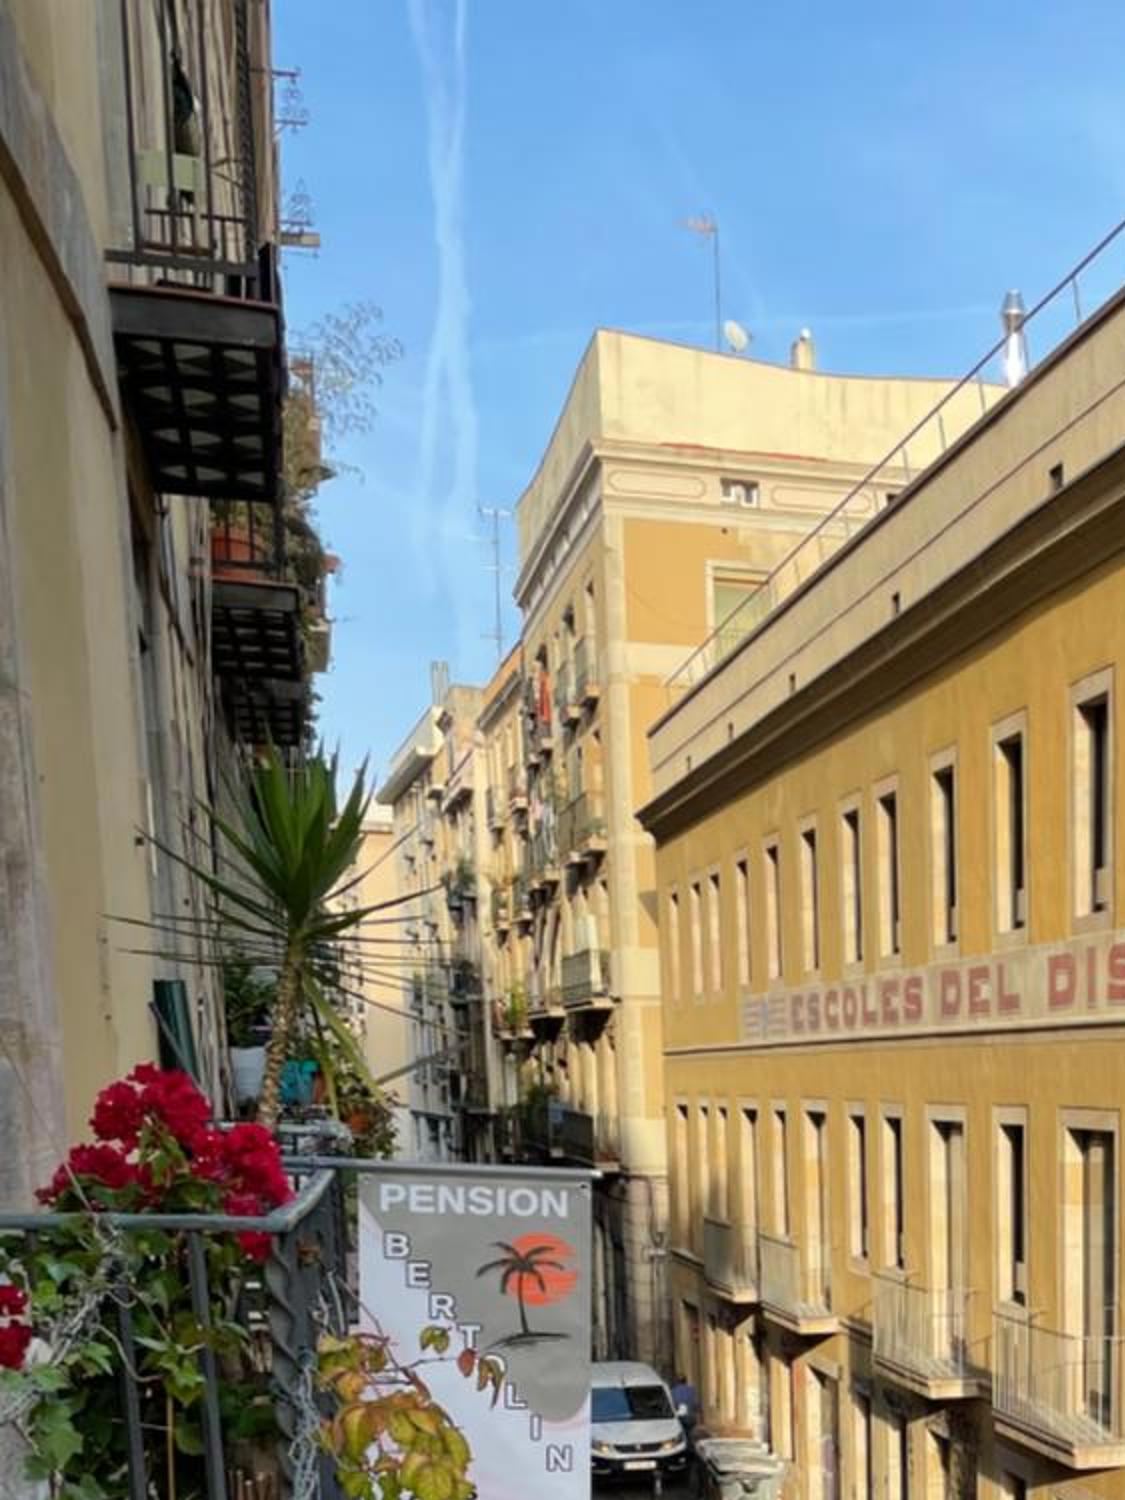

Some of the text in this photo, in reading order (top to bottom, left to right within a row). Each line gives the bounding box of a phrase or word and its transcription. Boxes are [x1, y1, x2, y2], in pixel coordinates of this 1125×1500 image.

[790, 975, 923, 1033] ESCOLES
[940, 966, 1021, 1017] DEL
[379, 1183, 569, 1219] PENSION
